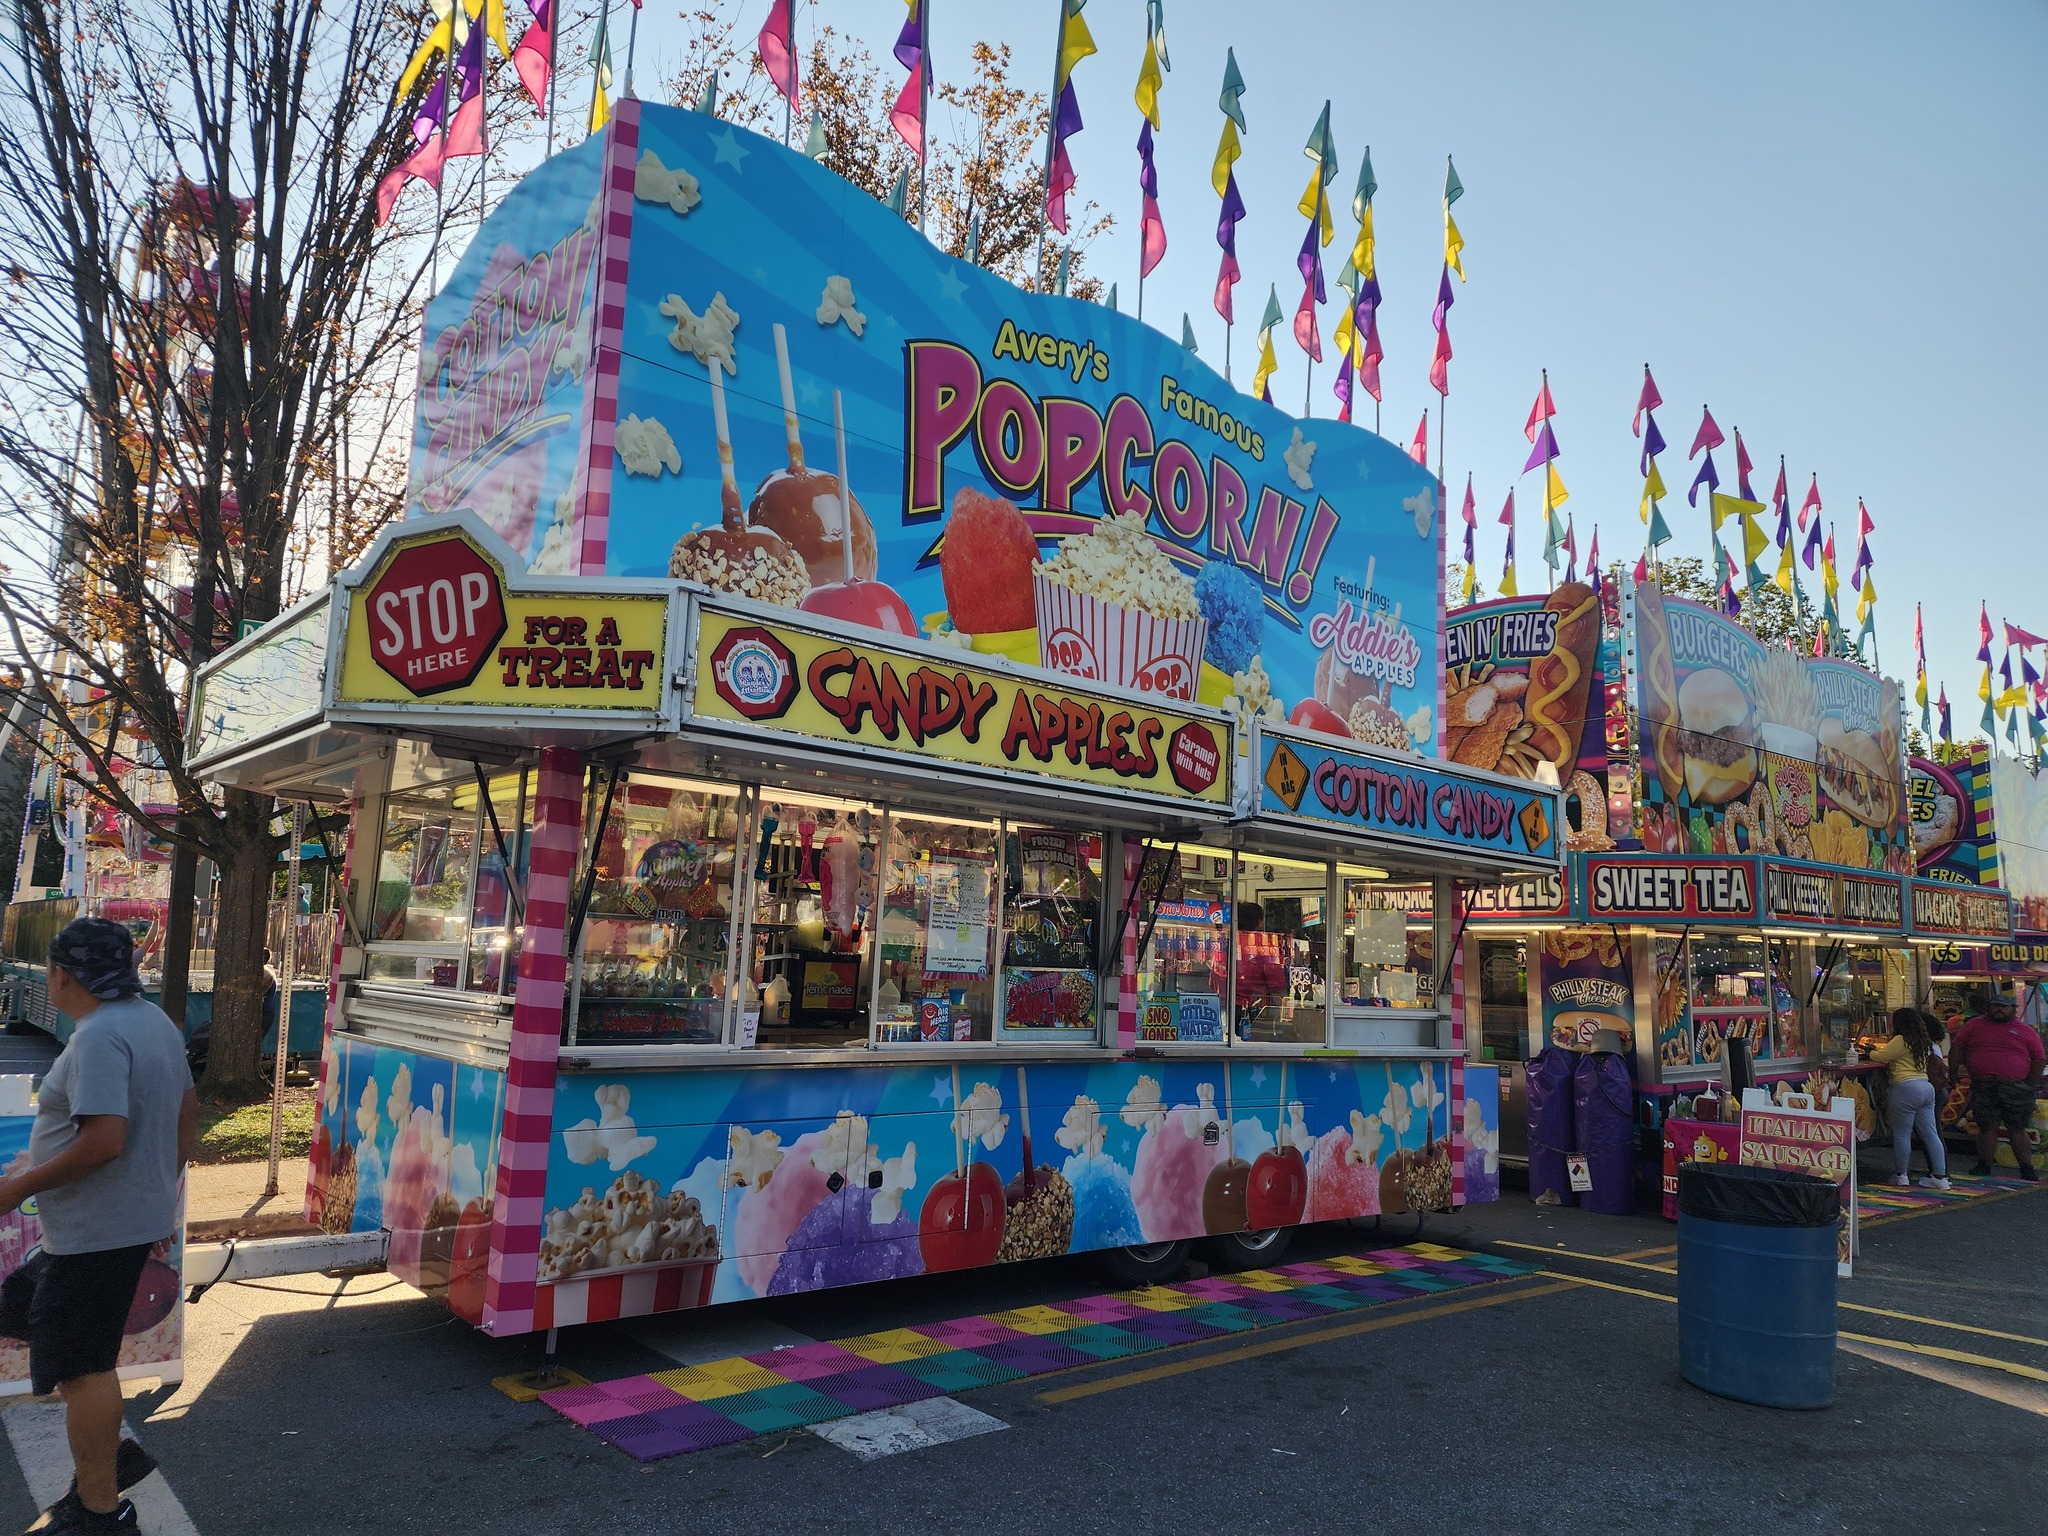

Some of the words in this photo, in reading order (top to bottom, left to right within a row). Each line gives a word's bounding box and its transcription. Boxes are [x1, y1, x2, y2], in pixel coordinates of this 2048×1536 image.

[424, 226, 583, 430] COTTON
[993, 317, 1109, 384] Avery's
[1160, 375, 1266, 463] Famous
[1333, 575, 1390, 611] Featuring:
[376, 572, 490, 657] STOP
[523, 616, 587, 645] FOR
[595, 617, 622, 645] A
[1310, 600, 1420, 667] Addie's
[1446, 623, 1471, 664] EN
[1500, 612, 1559, 658] FRIES
[407, 648, 469, 677] HERE
[1669, 612, 1750, 684] BURGERS
[498, 647, 654, 690] TREAT
[1139, 663, 1182, 692] POP
[1354, 655, 1413, 684] APPLES
[1816, 671, 1849, 710] PHILLY
[1850, 680, 1881, 725] STEAK
[807, 646, 998, 748] CANDY
[1001, 688, 1164, 780] APPLES
[1178, 733, 1217, 767] Caramel
[1278, 753, 1288, 766] IN
[1176, 751, 1193, 774] With
[1194, 762, 1212, 782] Nuts
[1283, 767, 1289, 780] A
[1281, 782, 1296, 797] BAG
[1314, 758, 1428, 830] COTTON
[1432, 783, 1515, 845] CANDY
[1911, 777, 1936, 799] EL
[1911, 802, 1936, 821] ES
[1031, 835, 1066, 850] FROZEN
[1024, 848, 1076, 867] LEMONADE
[1597, 867, 1686, 910] SWEET
[1694, 868, 1749, 911] TEA
[1768, 870, 1791, 913] PHILLY
[1843, 879, 1870, 920] ITALIAN
[1870, 883, 1900, 922] SAUSAGE
[628, 895, 652, 918] EBBLES
[1915, 890, 1960, 927] NACHOS
[1930, 944, 1961, 962] GS
[1991, 945, 2029, 961] COLD
[2033, 945, 2048, 962] DR
[806, 983, 852, 996] lemonade
[1193, 998, 1209, 1006] COLD
[1551, 980, 1587, 1002] PHILLY
[1590, 980, 1628, 1002] STEAK
[1579, 992, 1612, 1005] Cheese
[930, 1016, 949, 1027] HEADS
[938, 1007, 949, 1017] AIR
[1147, 1004, 1171, 1026] SNO
[1142, 1025, 1177, 1041] KONES
[1181, 1022, 1215, 1036] WATER
[1694, 1020, 1708, 1056] PRETZELS
[1748, 1115, 1845, 1144] ITALIAN
[1742, 1140, 1850, 1171] SAUSAGE
